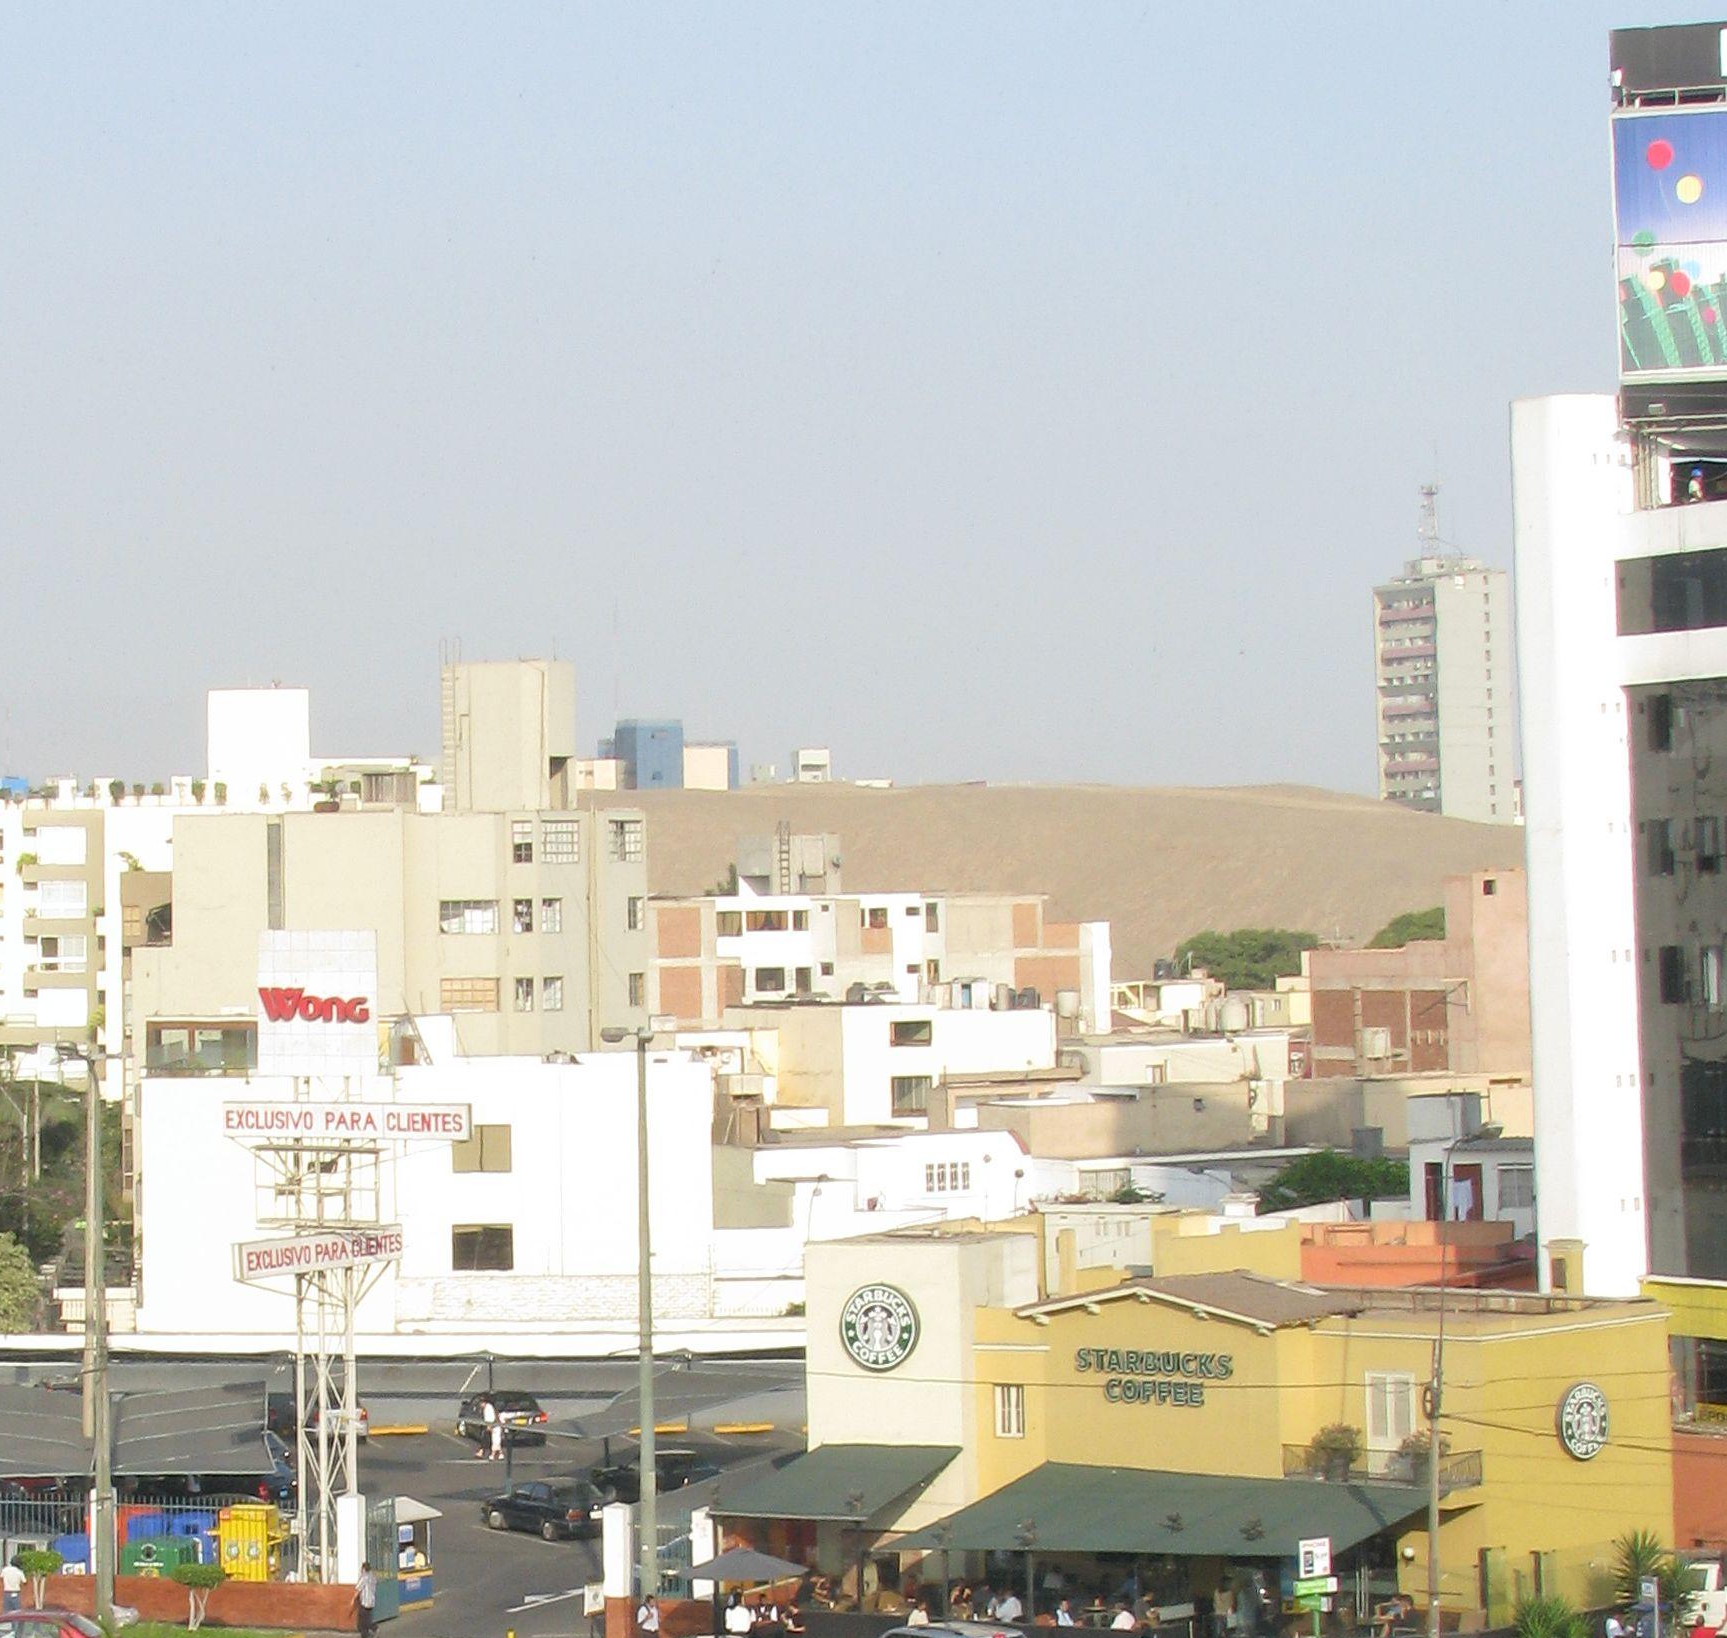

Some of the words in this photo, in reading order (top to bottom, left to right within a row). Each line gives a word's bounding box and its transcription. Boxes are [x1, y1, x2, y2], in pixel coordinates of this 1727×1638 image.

[225, 1109, 313, 1131] EXCLUSIVO
[325, 1111, 377, 1131] PARA
[386, 1111, 463, 1133] CLIENTES
[247, 1245, 311, 1272] EXCLUSIVO
[315, 1241, 349, 1263] PARA
[351, 1233, 403, 1258] CLIENTES
[846, 1289, 911, 1327] STARBUCKS
[853, 1341, 904, 1364] COFFEE
[1075, 1347, 1233, 1380] STARBUCKS
[1104, 1378, 1206, 1408] COFFEE
